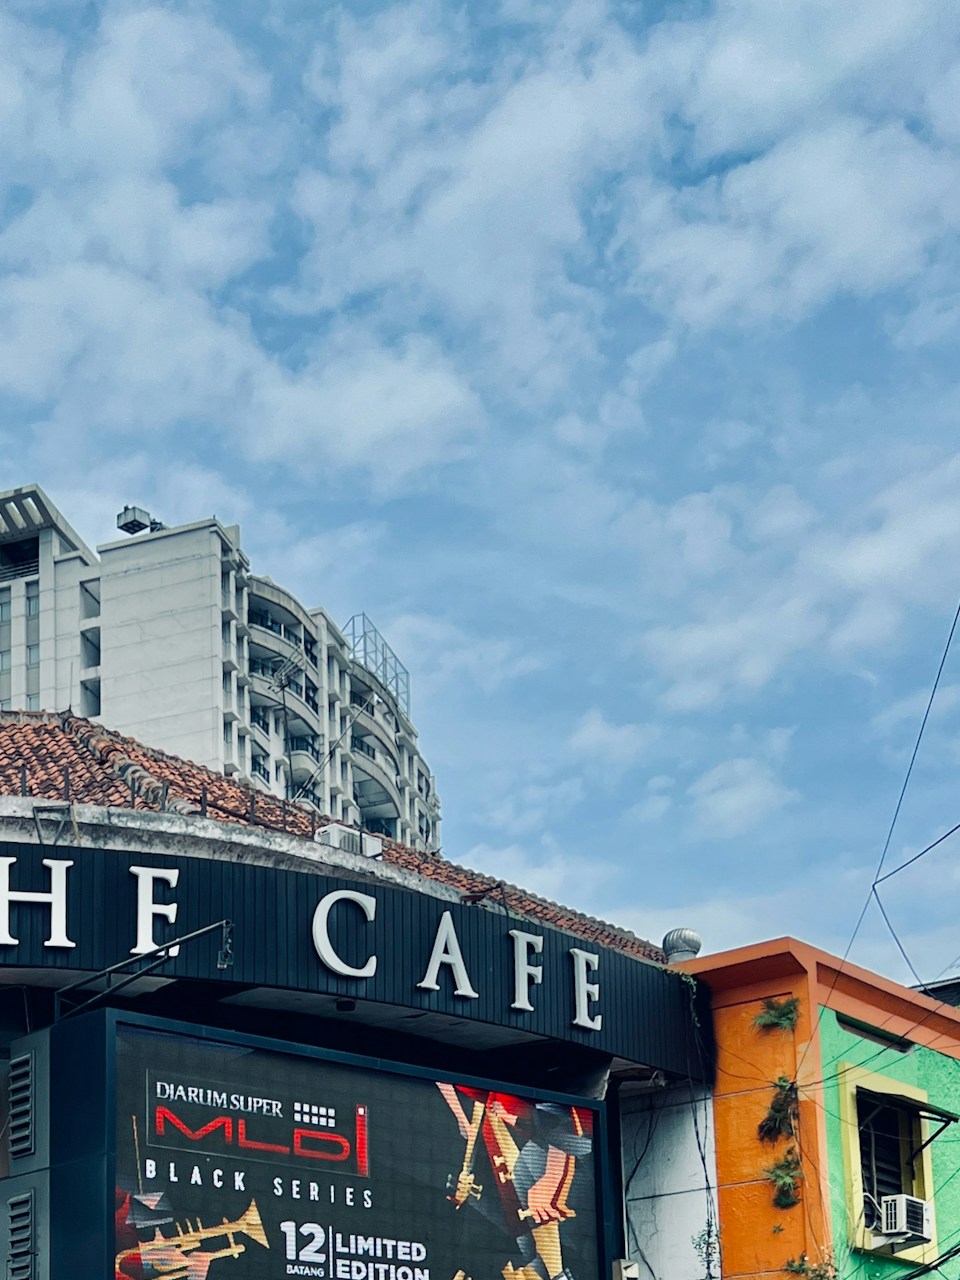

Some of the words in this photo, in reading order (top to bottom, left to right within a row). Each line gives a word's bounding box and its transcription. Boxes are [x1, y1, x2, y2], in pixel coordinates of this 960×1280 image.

[312, 888, 603, 1031] CAFE
[156, 1081, 228, 1109] DJARUM
[230, 1093, 283, 1118] SUPER
[145, 1159, 246, 1192] BLACK
[273, 1176, 373, 1209] SERIES
[280, 1220, 327, 1264] 12
[335, 1232, 427, 1263] LIMITED
[286, 1264, 325, 1279] BATANG
